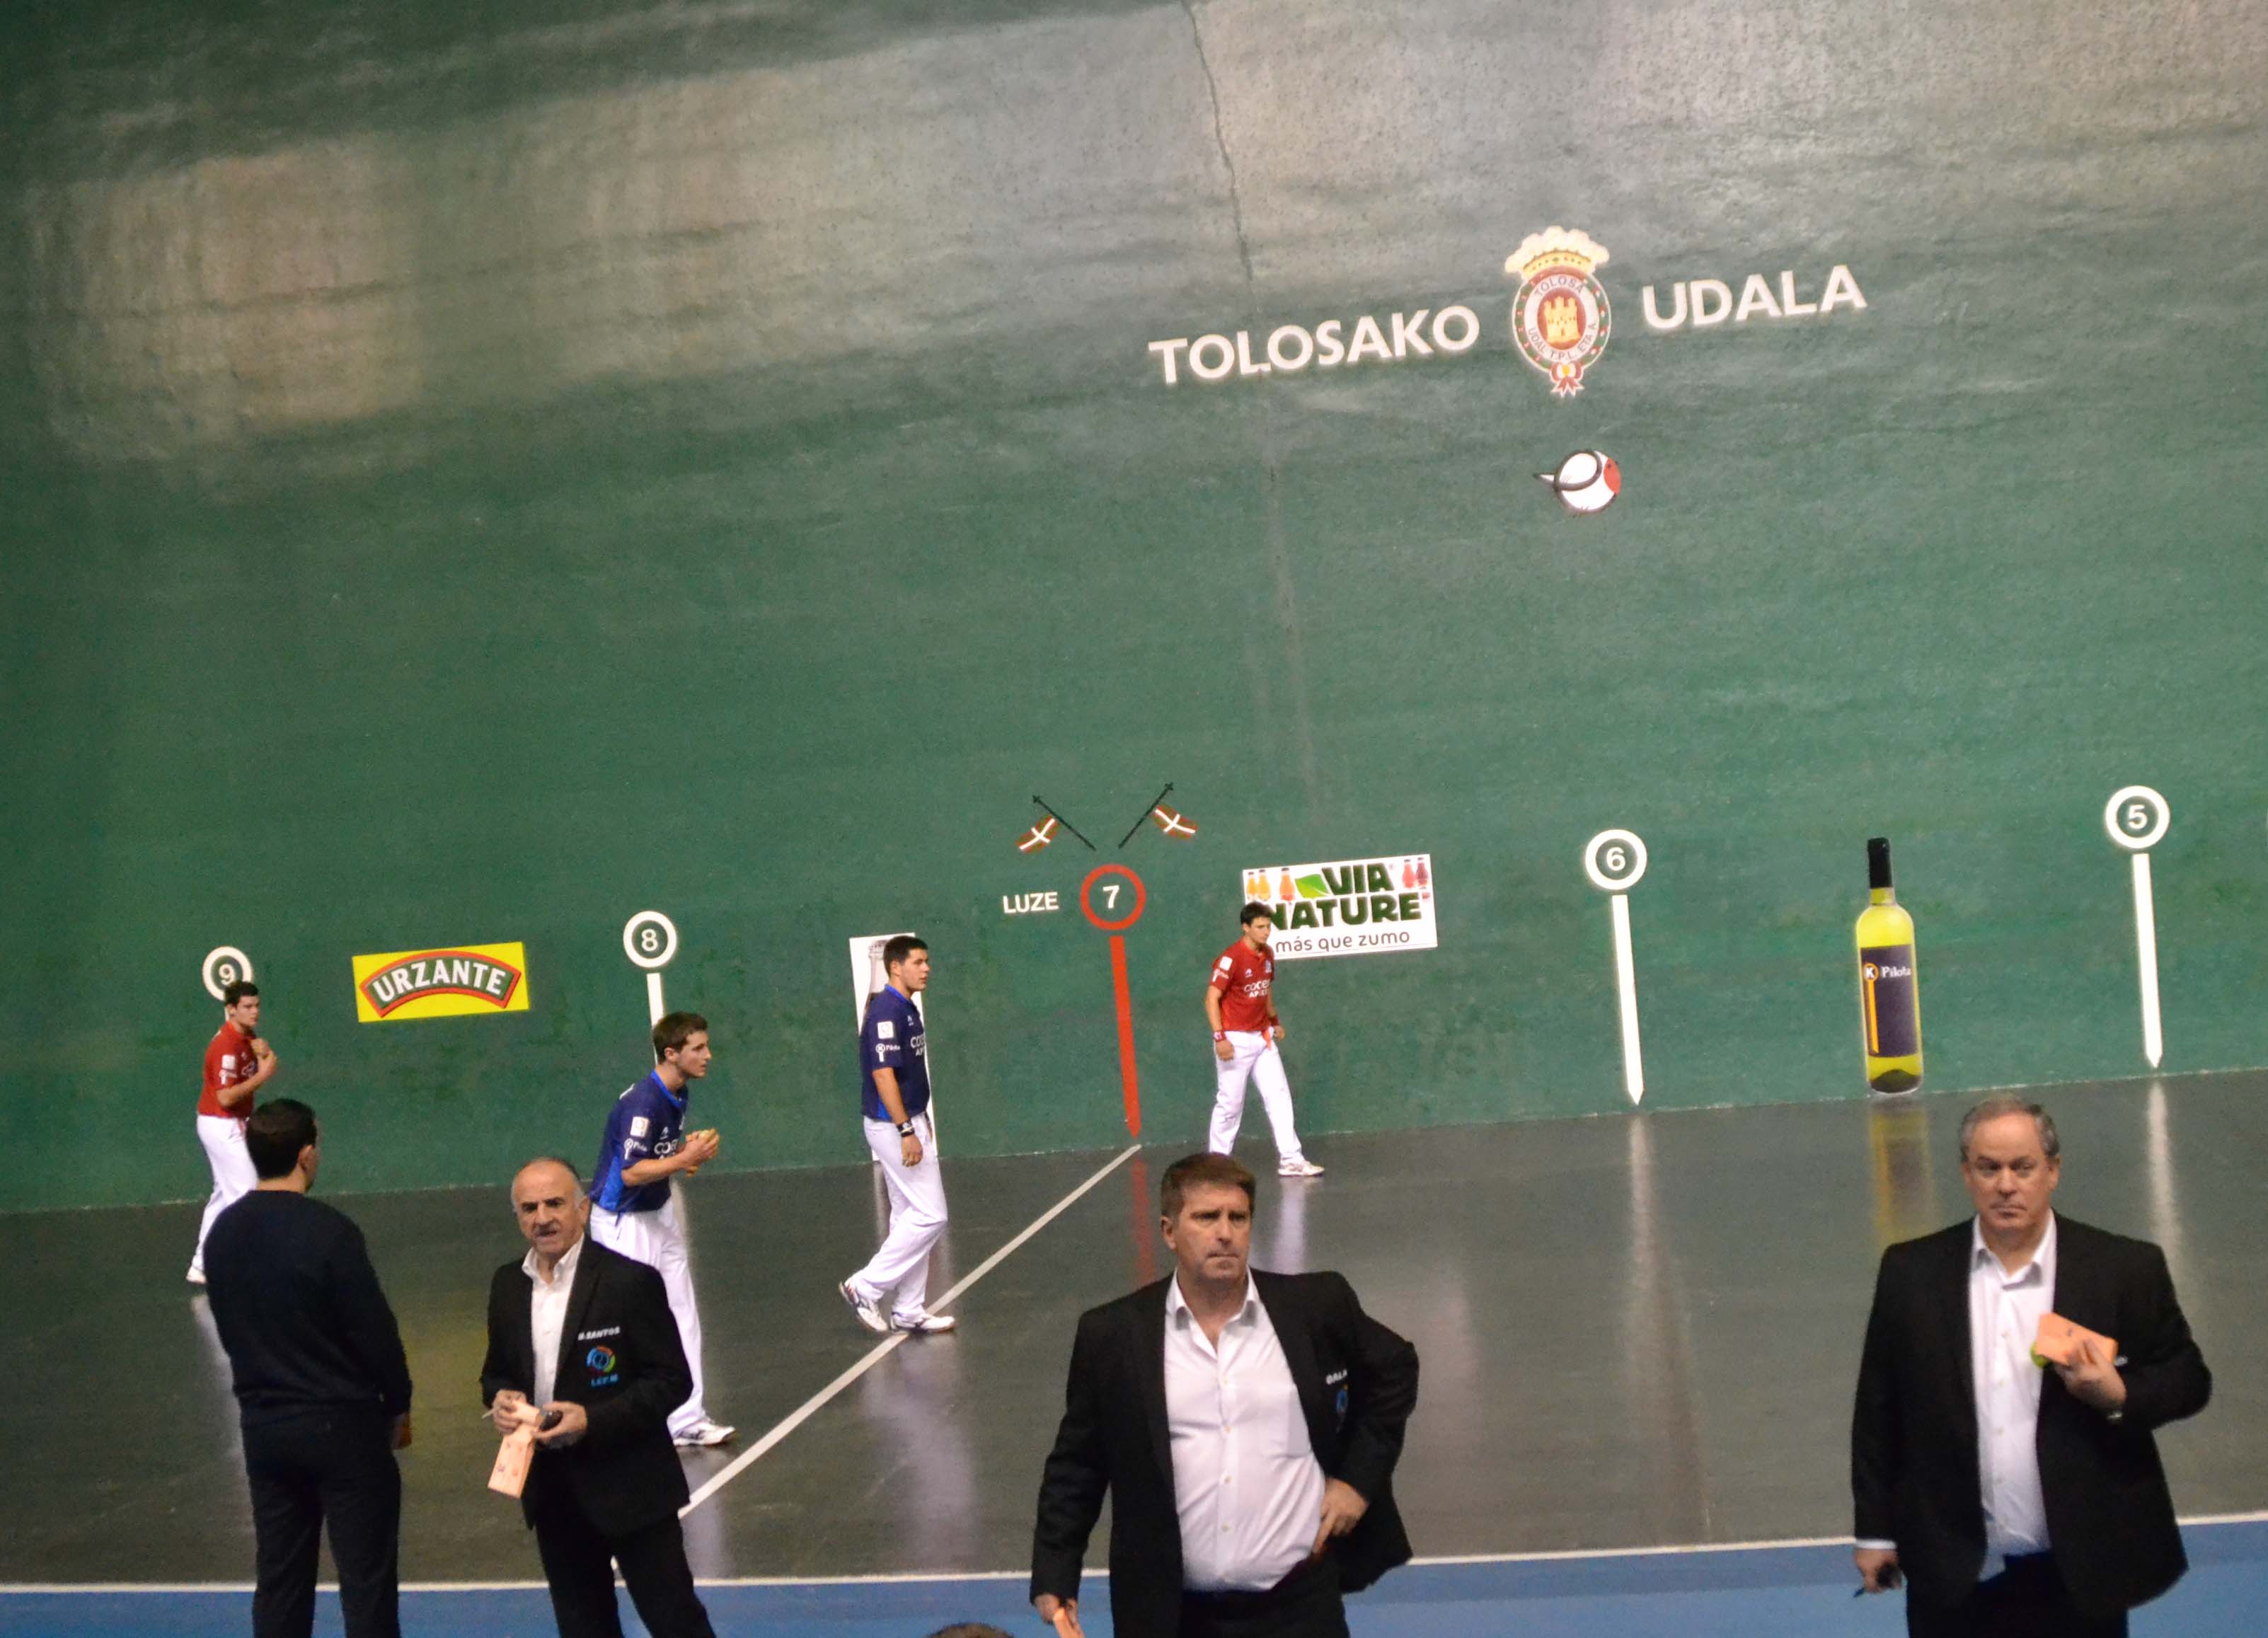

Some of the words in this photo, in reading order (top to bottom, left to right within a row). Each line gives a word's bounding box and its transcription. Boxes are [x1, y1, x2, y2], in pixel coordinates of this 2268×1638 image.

[1534, 276, 1585, 296] TOLOSA
[1149, 305, 1480, 384] TOLOSAKO
[1642, 264, 1868, 329] UDALA
[2127, 804, 2148, 829] 5
[1606, 846, 1626, 871] 6
[1321, 863, 1395, 896] VIA
[1003, 892, 1059, 913] LUZE
[1103, 884, 1120, 909] 7
[640, 928, 659, 952] 8
[1275, 935, 1313, 953] más
[1318, 935, 1353, 952] que
[1359, 931, 1411, 947] zumo
[218, 963, 236, 986] 9
[372, 959, 506, 1003] URZANTE
